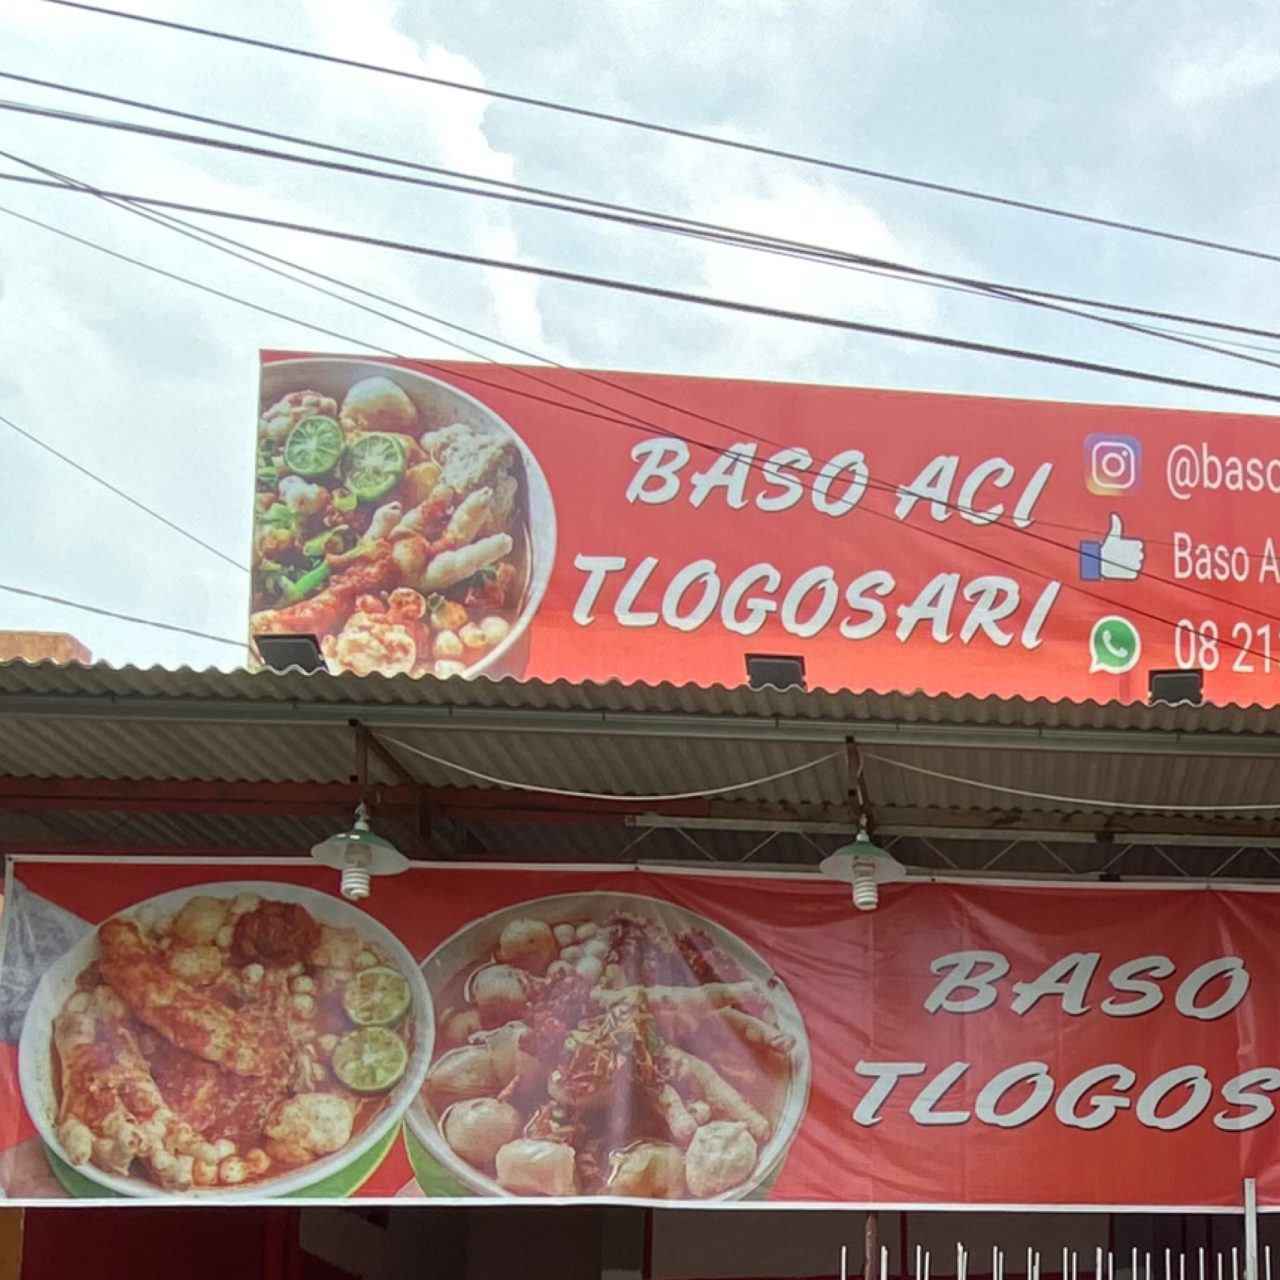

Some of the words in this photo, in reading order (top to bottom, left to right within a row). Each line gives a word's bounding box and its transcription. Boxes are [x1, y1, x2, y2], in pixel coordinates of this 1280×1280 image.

[626, 437, 869, 517] BASO
[895, 454, 1053, 528] ACI
[1173, 532, 1250, 582] Baso
[573, 553, 1061, 649] TLOGOSARI
[1175, 618, 1218, 671] 08
[923, 949, 1251, 1021] BASO
